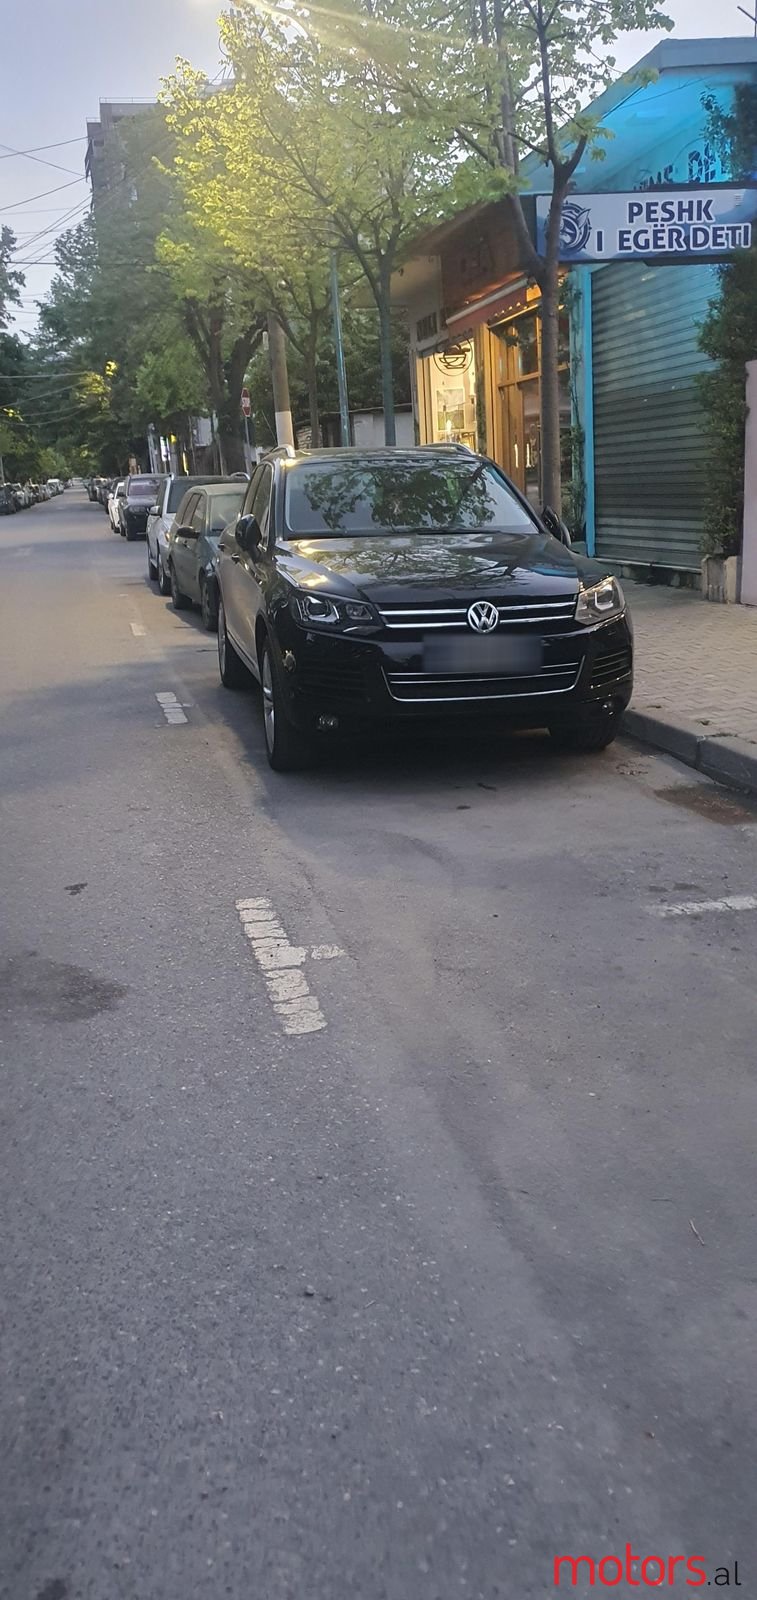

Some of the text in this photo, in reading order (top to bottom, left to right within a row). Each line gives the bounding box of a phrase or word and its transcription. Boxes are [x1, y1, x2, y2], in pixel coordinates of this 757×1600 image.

[628, 200, 714, 224] PESHK
[597, 223, 750, 252] I EGËR DETI
